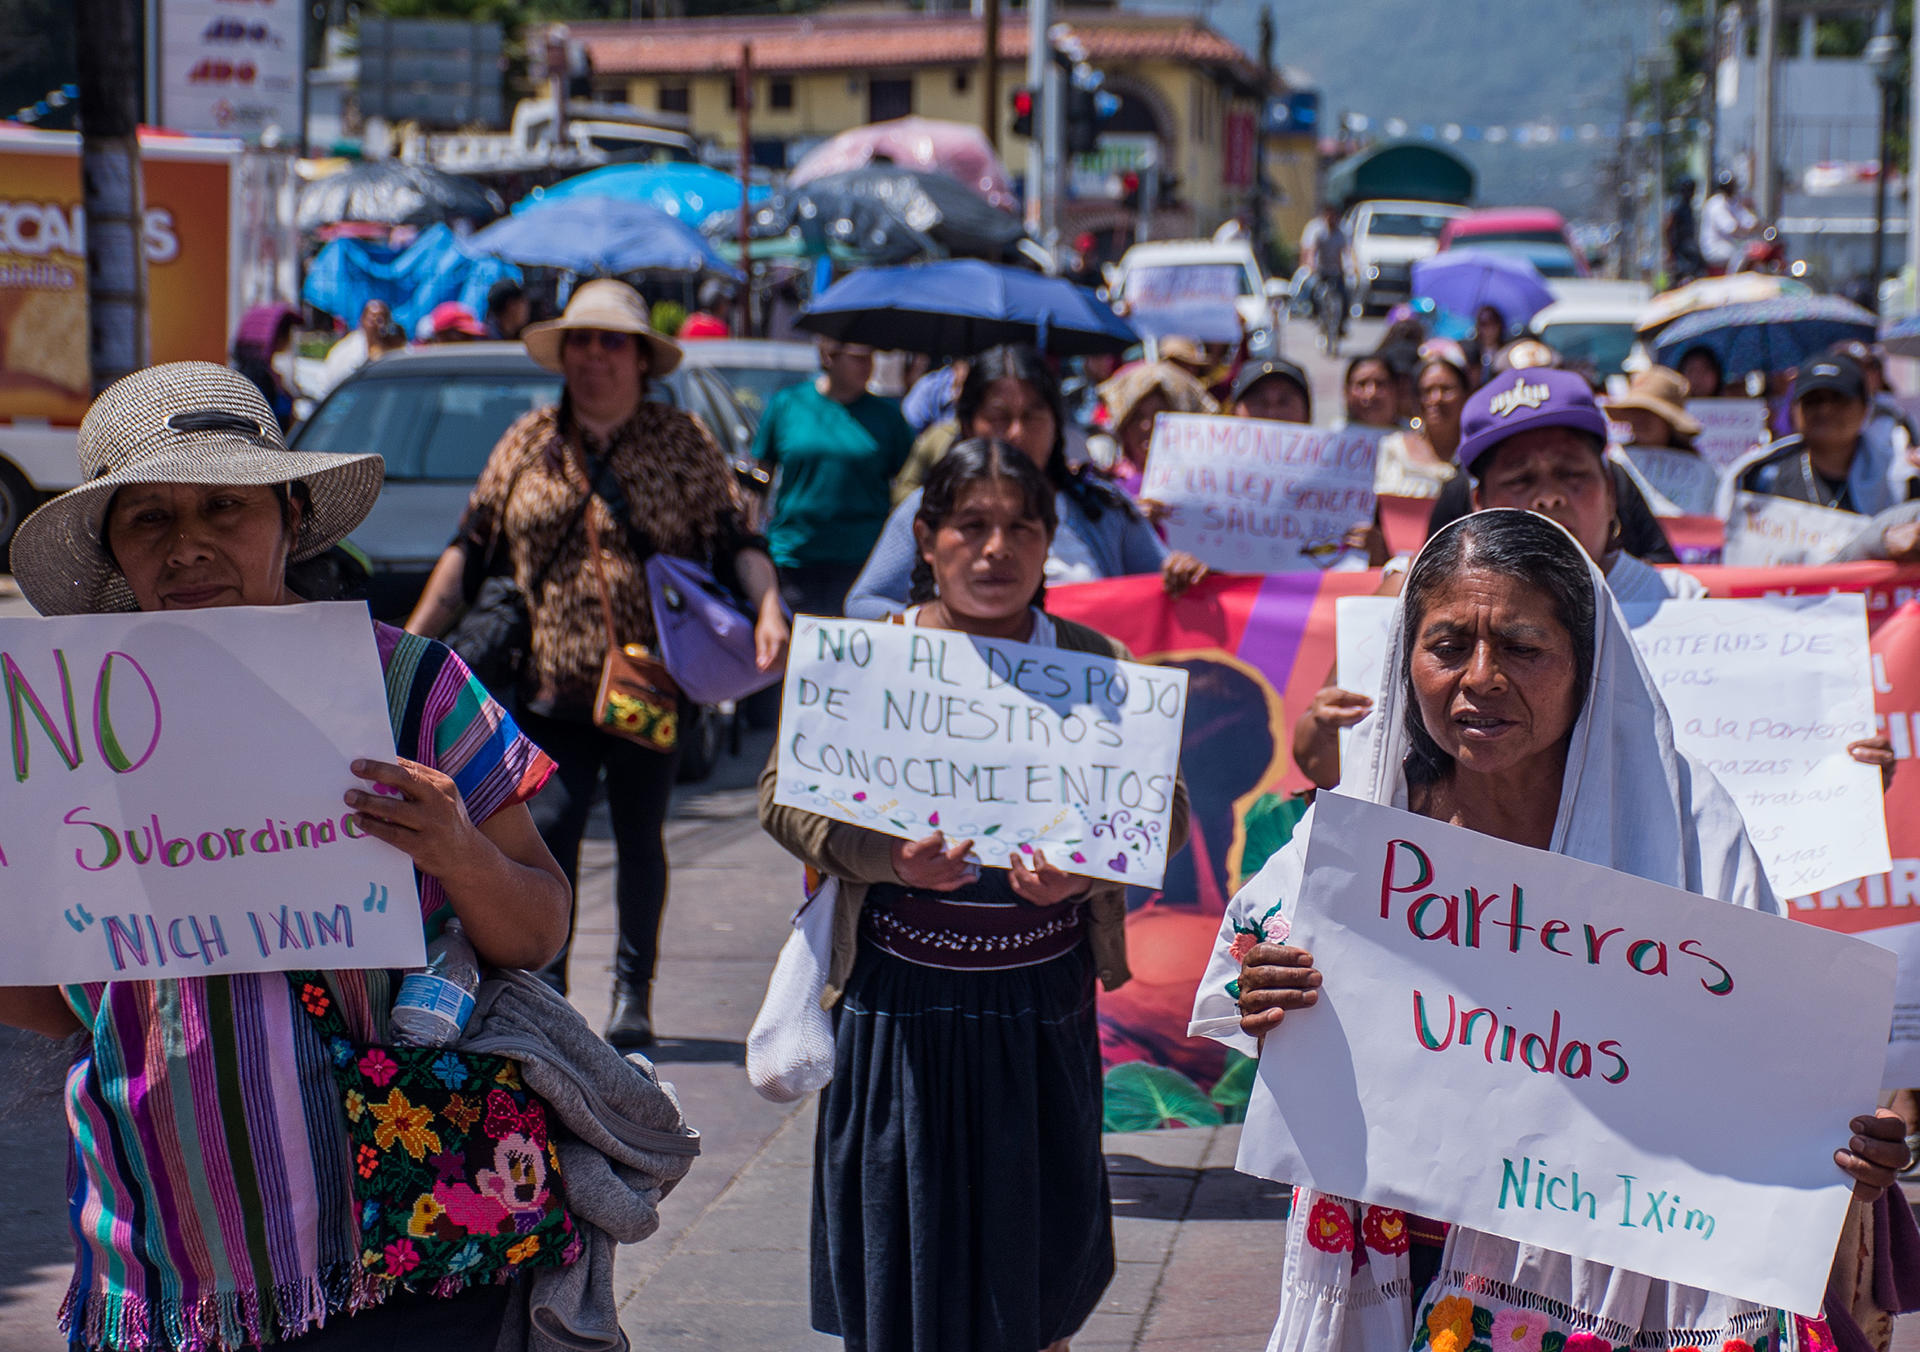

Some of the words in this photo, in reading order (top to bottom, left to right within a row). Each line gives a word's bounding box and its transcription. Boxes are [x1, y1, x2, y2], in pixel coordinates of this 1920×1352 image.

[1185, 466, 1218, 496] LA
[1225, 470, 1276, 508] LEY
[817, 628, 872, 668] NO
[909, 635, 961, 686] AL
[985, 647, 1181, 718] DESPOJO
[1779, 632, 1835, 657] DE
[0, 648, 162, 783] NO
[799, 677, 850, 722] DE
[884, 689, 1124, 748] NUESTROS
[792, 732, 1170, 814] CONOCIMIENTOS
[63, 806, 372, 872] Subordinac
[1380, 839, 1734, 996] Parteras
[1413, 989, 1630, 1084] Unidas
[1498, 1157, 1596, 1220] Nich
